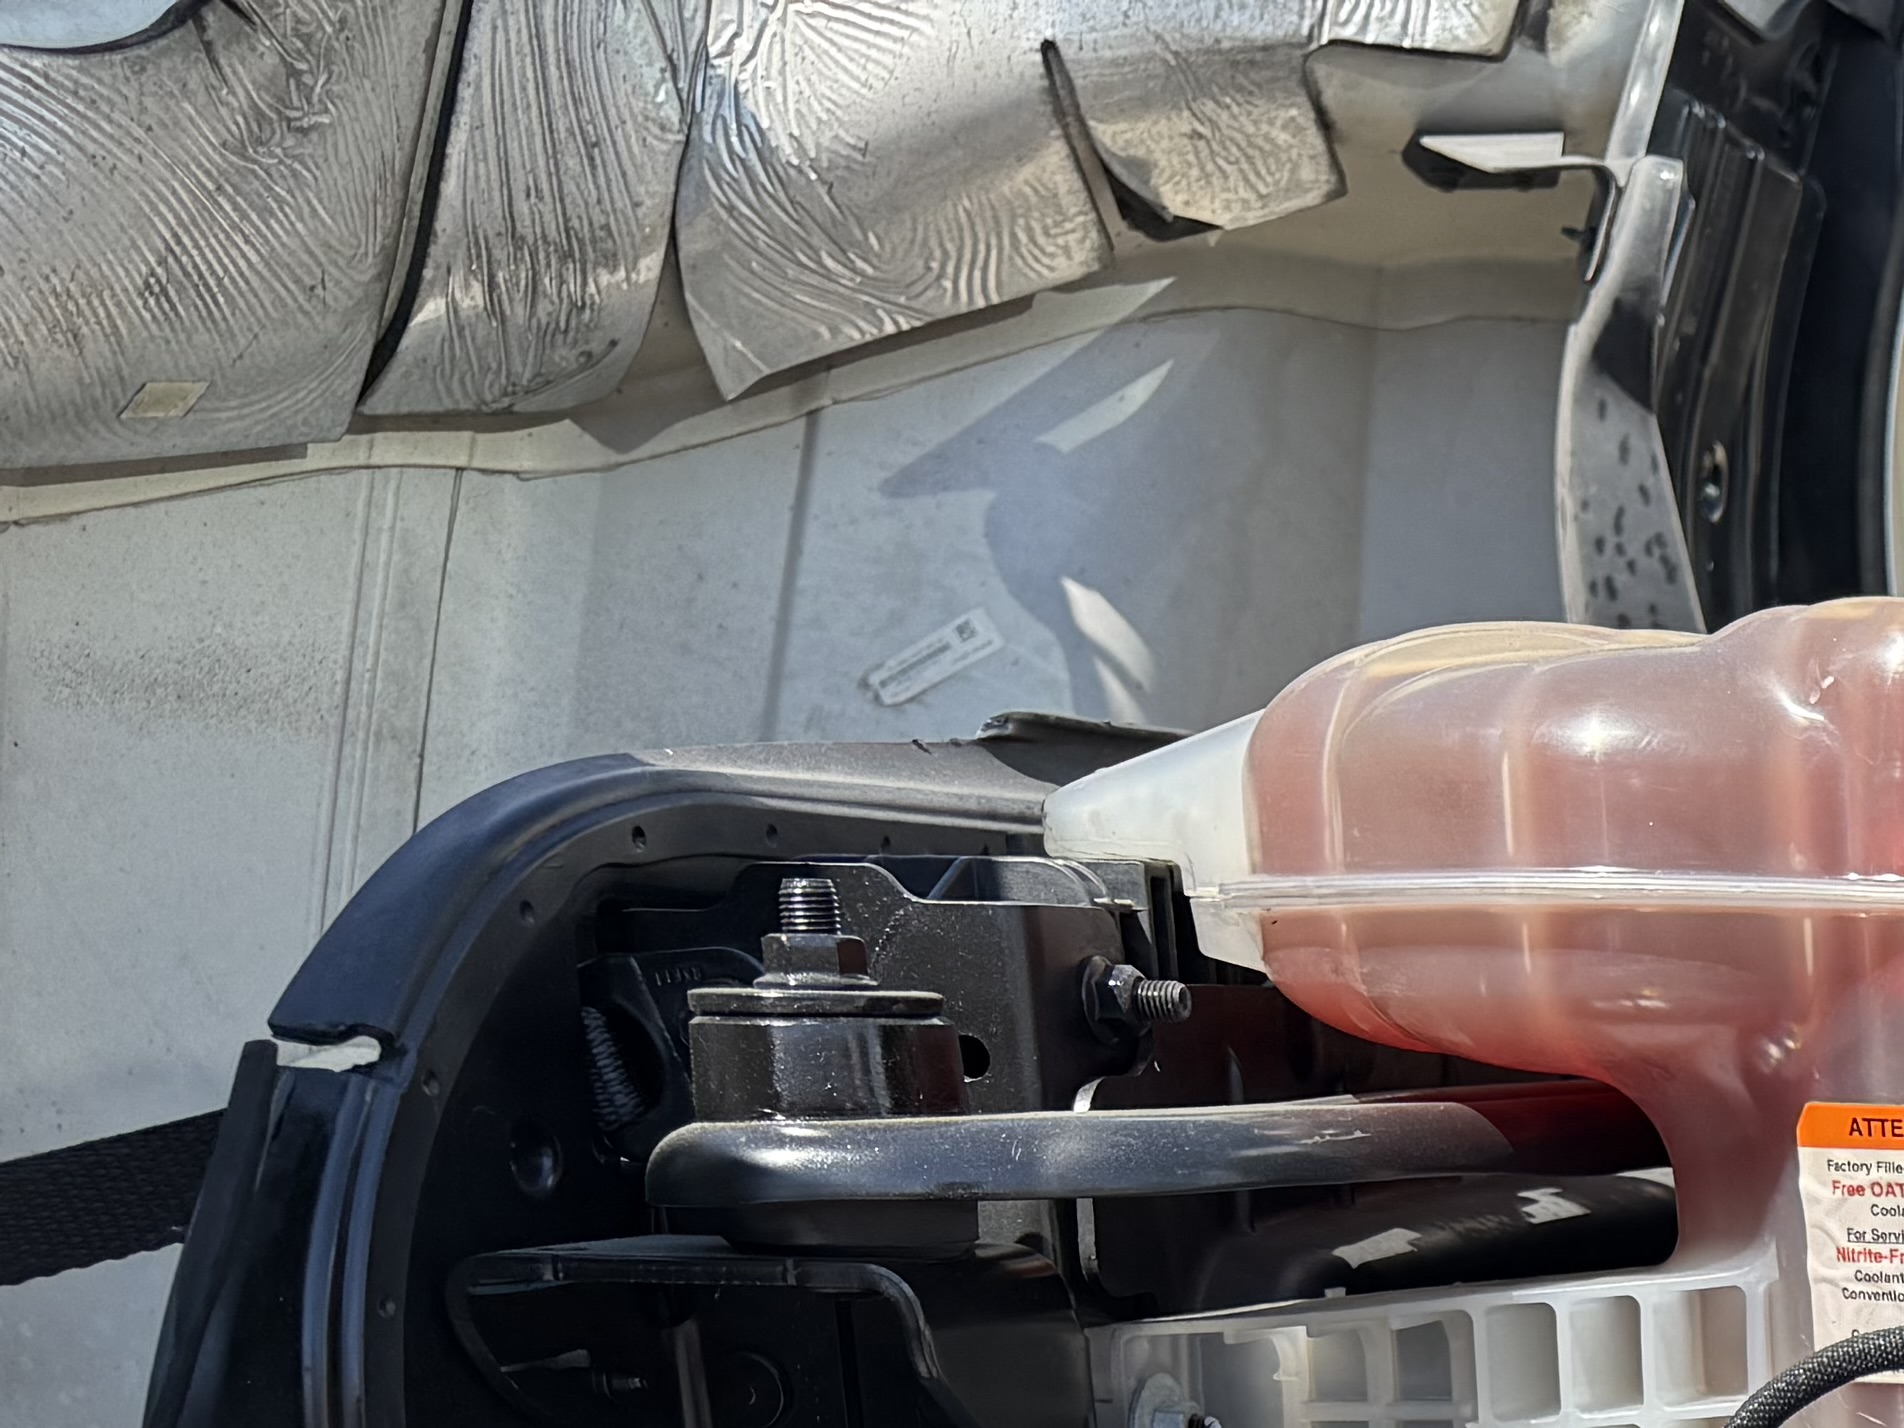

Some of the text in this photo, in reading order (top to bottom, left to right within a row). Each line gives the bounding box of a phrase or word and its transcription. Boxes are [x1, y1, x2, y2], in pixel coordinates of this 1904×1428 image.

[1827, 1159, 1872, 1176] Factory
[1832, 1181, 1865, 1197] Free
[1847, 1228, 1867, 1243] For
